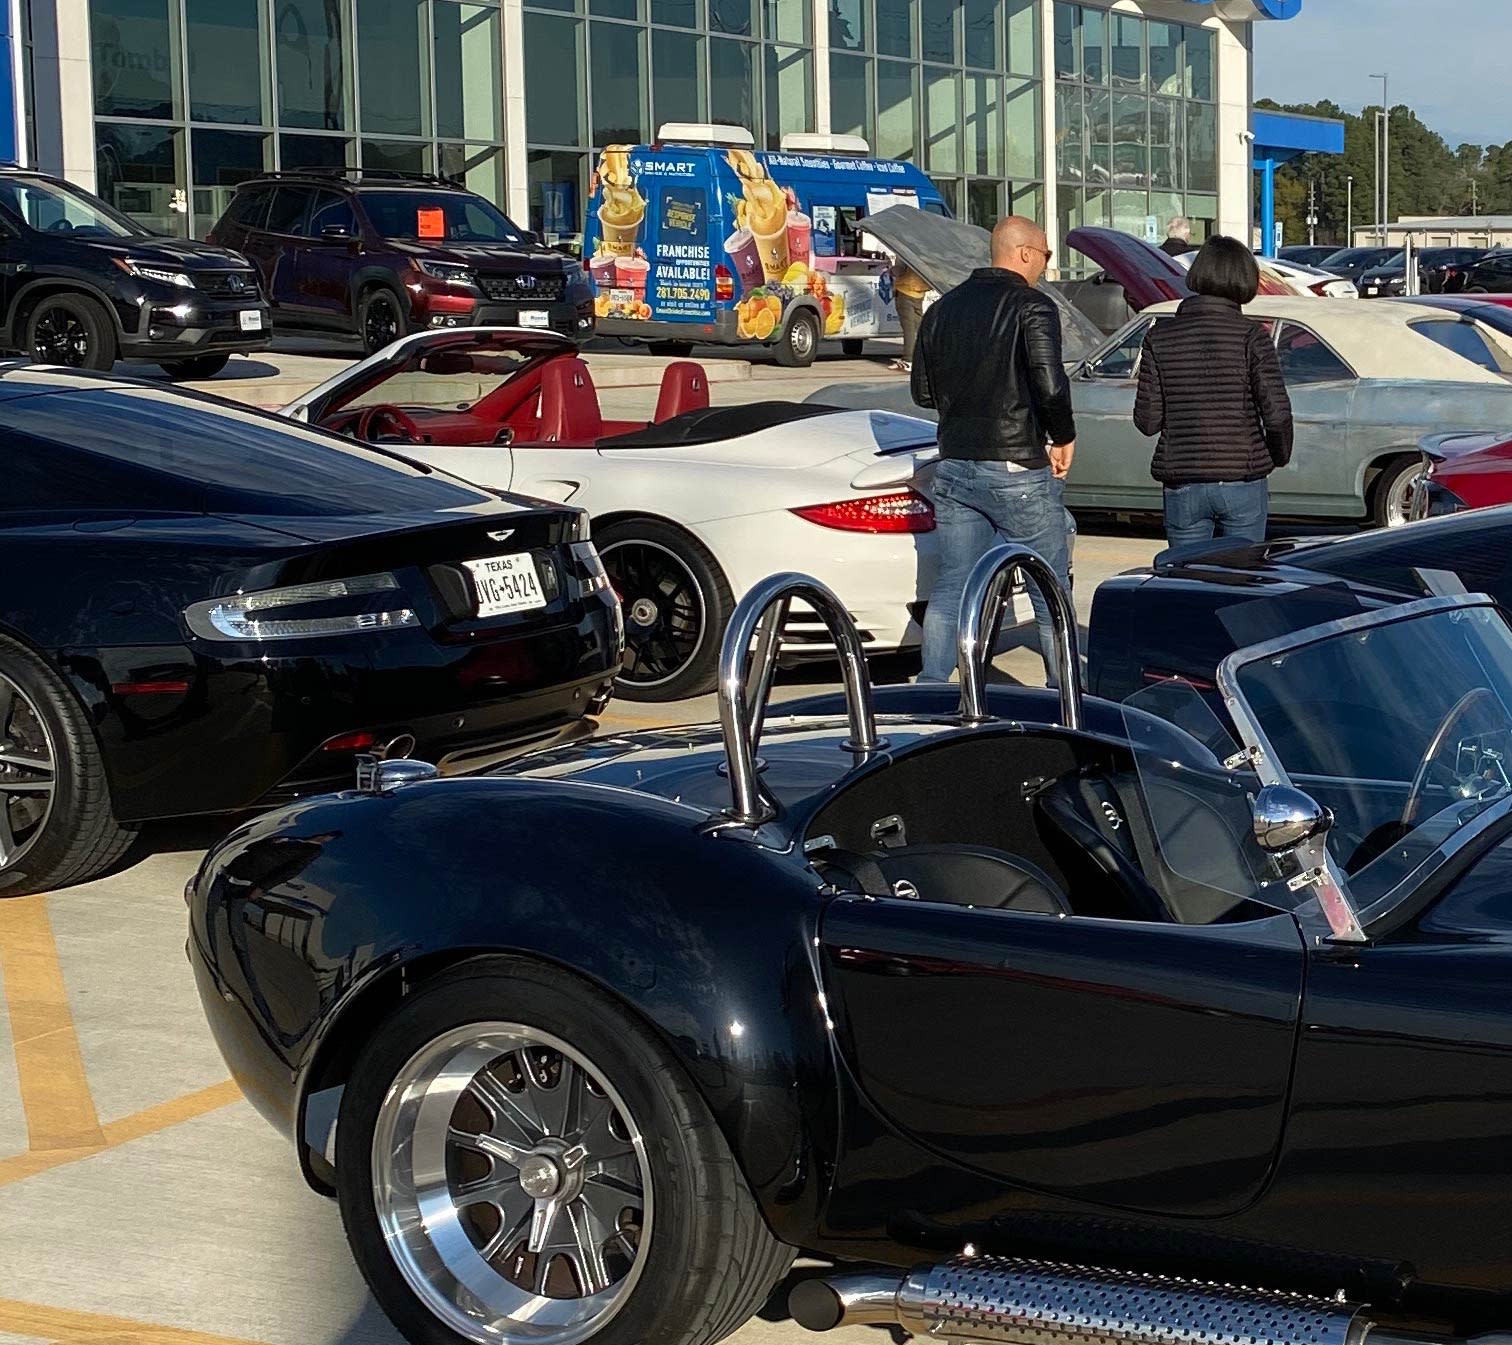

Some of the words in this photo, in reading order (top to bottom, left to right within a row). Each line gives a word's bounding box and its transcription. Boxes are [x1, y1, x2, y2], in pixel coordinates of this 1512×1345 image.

[645, 161, 696, 173] SMART
[656, 244, 710, 259] FRANCHISE
[656, 266, 711, 280] AVAILABLE!
[484, 559, 513, 573] TEXAS
